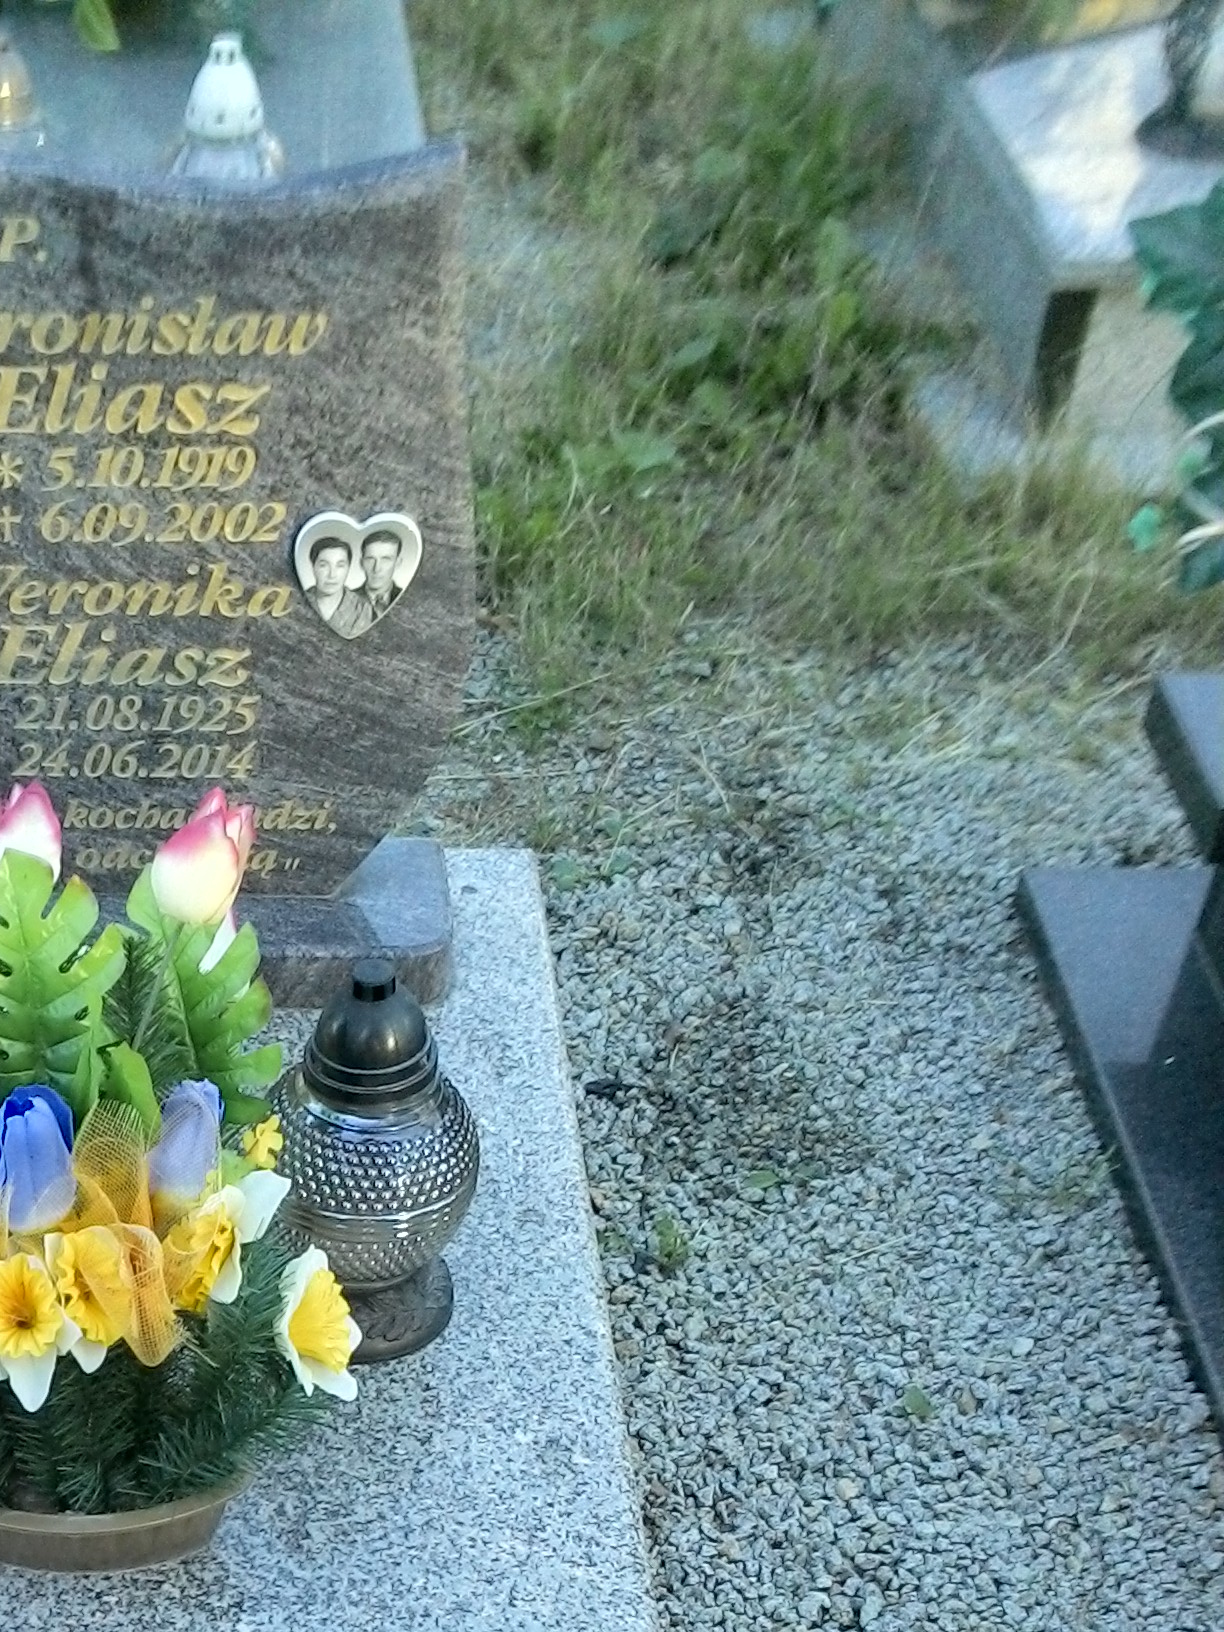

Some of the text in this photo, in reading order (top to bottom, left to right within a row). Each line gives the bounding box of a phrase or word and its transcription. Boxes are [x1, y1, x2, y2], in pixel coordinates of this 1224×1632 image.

[41, 445, 257, 492] 5.10.1919
[40, 500, 287, 546] 6.09.2002
[13, 695, 262, 735] 21.08.1925
[11, 740, 259, 780] 24.06.2014
[63, 797, 198, 831] kocha
